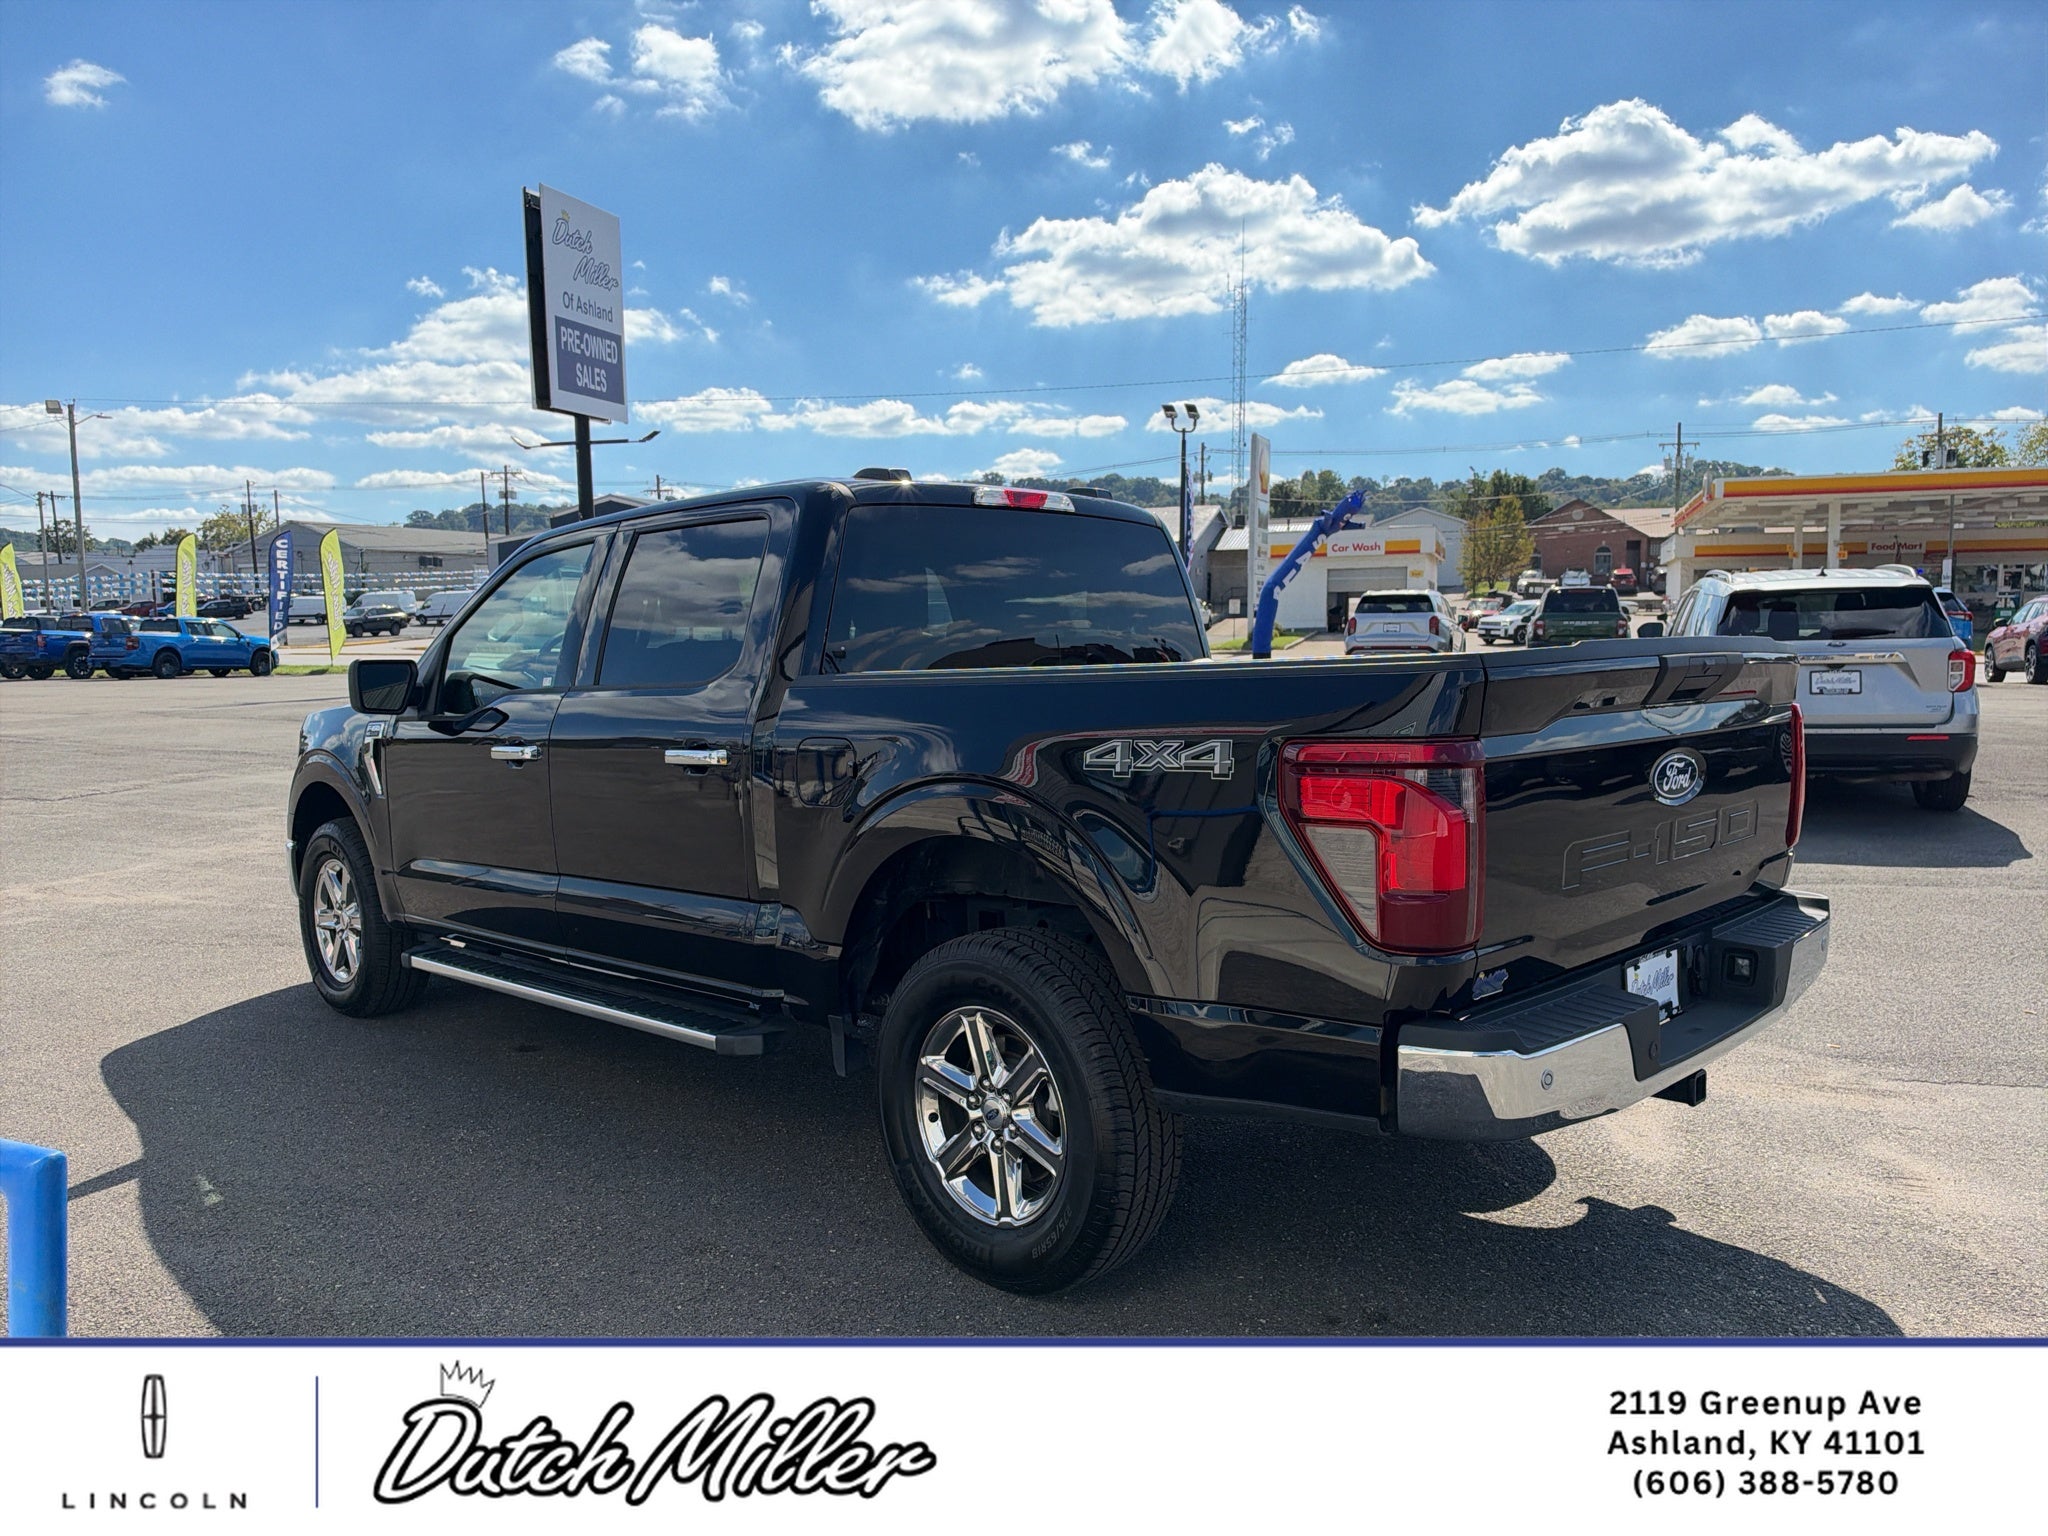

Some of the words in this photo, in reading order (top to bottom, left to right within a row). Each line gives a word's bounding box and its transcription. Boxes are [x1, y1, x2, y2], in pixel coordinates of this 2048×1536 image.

[552, 217, 593, 255] Dutch
[573, 255, 619, 292] Miller
[562, 291, 575, 310] Of
[576, 296, 614, 323] Ashland
[560, 325, 618, 365] PRE-OWNED
[576, 362, 607, 393] SALES
[1331, 543, 1349, 553] Car
[1352, 540, 1381, 552] Wash
[1871, 542, 1896, 551] Food
[1898, 541, 1923, 551] Mart
[273, 539, 289, 631] CERTIFIED
[1663, 760, 1692, 792] Ford
[1562, 800, 1759, 890] F-150
